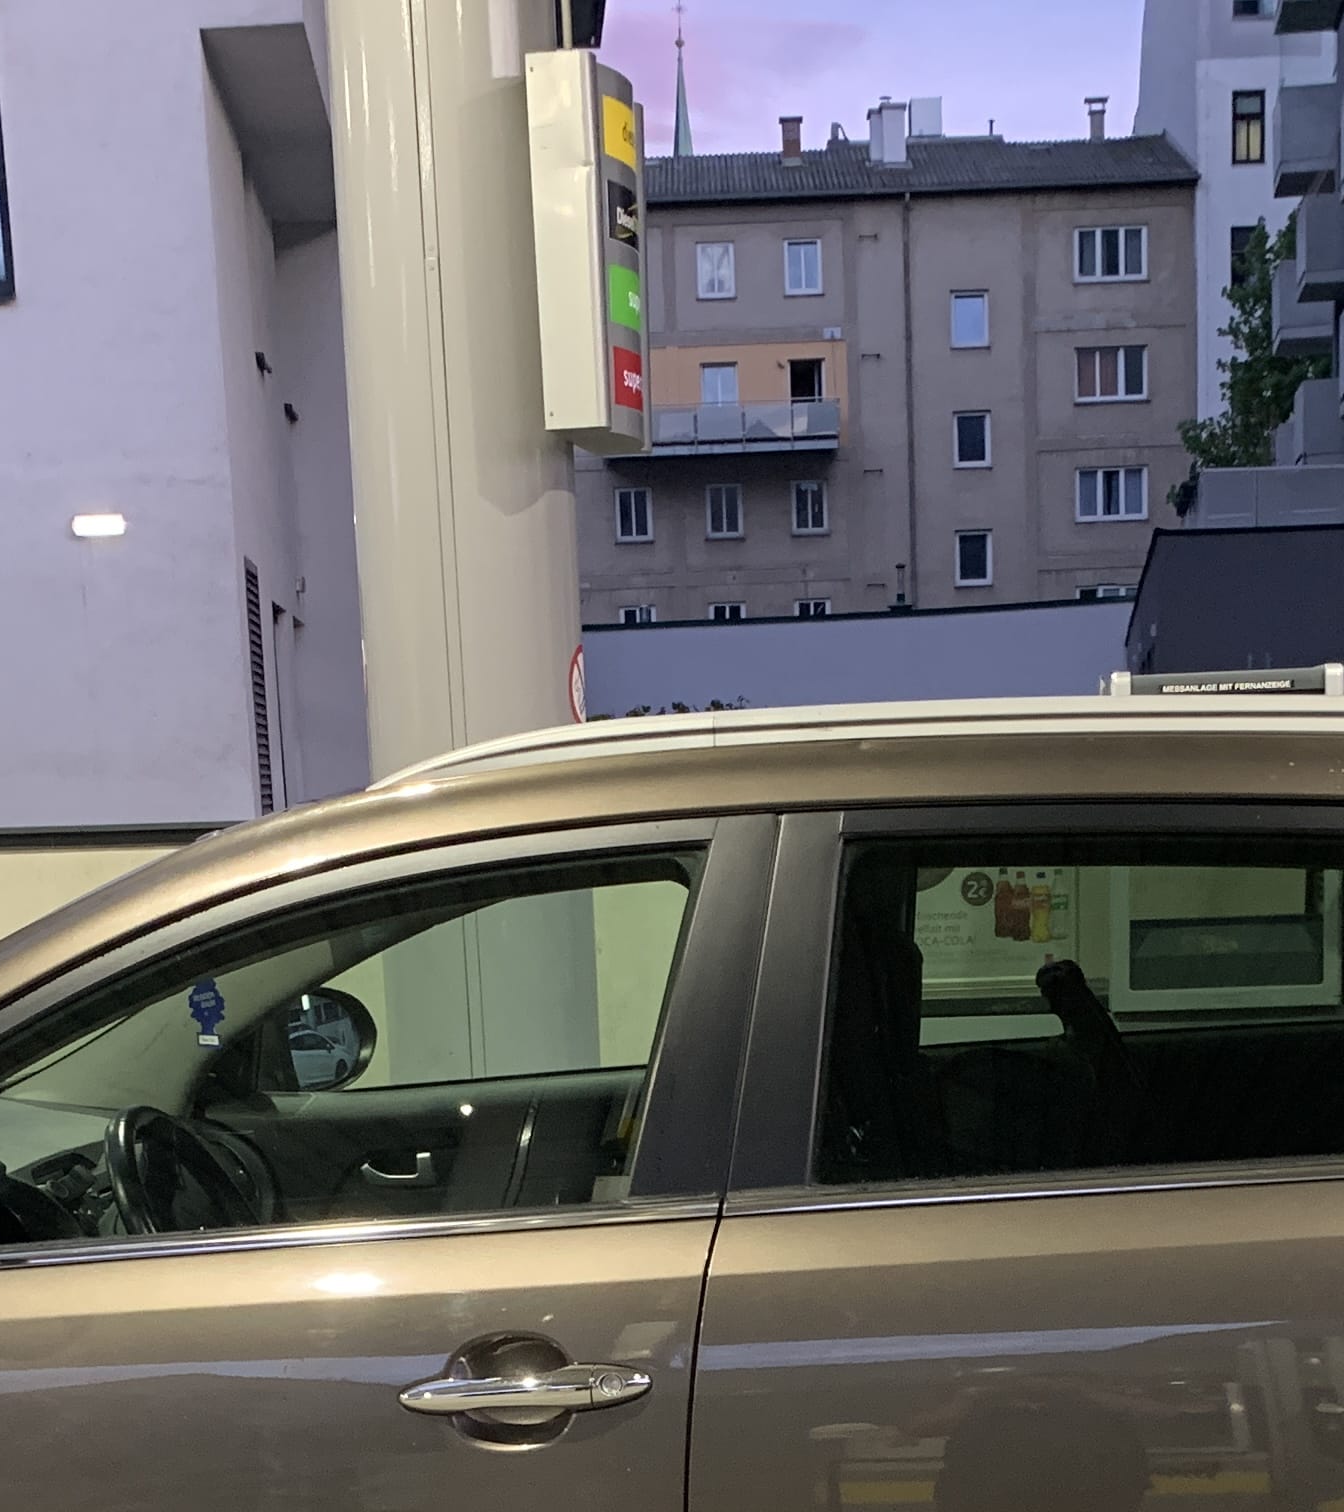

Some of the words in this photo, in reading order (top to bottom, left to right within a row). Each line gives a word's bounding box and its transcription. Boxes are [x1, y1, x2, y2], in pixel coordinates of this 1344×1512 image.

[1162, 684, 1218, 693] MESSANLAGE
[1219, 682, 1234, 691] MIT
[1234, 679, 1291, 691] FERNANZEIGE
